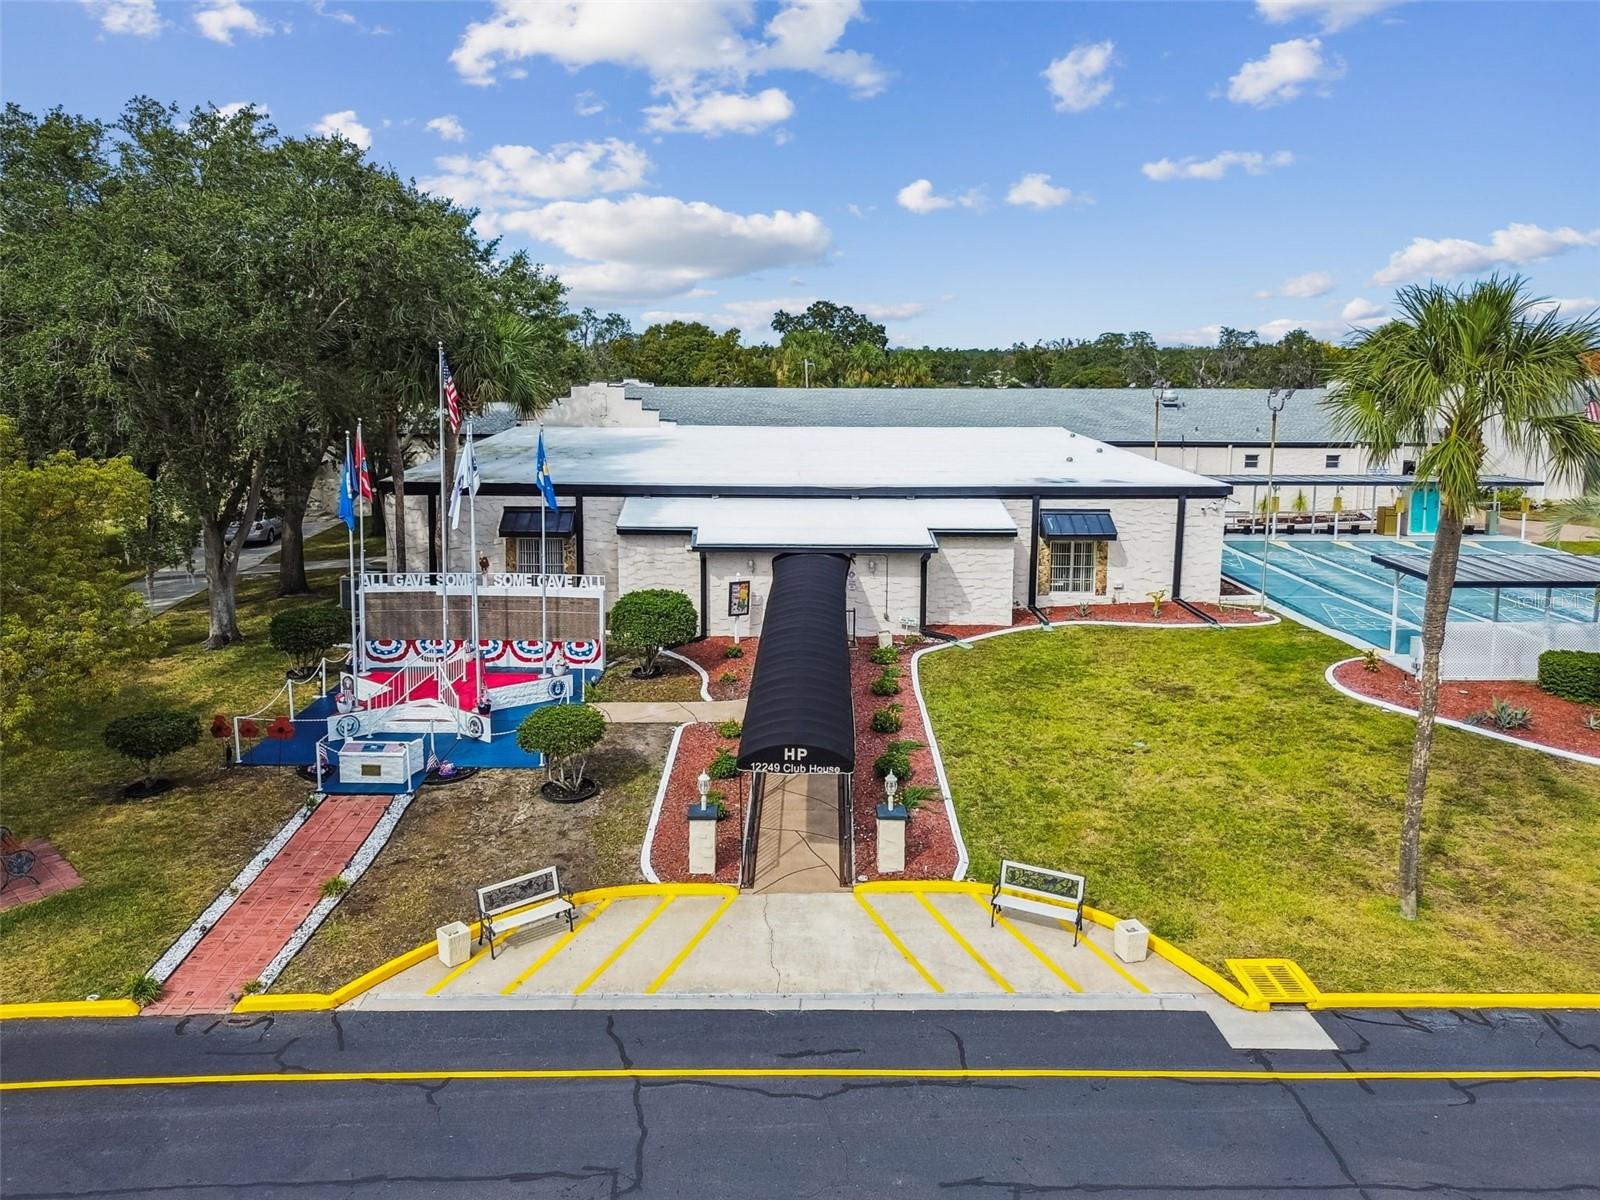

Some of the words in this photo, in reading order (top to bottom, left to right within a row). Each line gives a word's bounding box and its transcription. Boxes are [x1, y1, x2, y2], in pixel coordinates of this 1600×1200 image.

[363, 574, 388, 586] ALL
[393, 574, 431, 586] GAVE
[494, 574, 532, 587] SOME
[537, 575, 573, 588] GAVE
[579, 576, 605, 588] ALL
[784, 747, 808, 761] HP
[750, 762, 780, 773] 12249
[783, 763, 806, 773] Club
[809, 764, 841, 774] House
